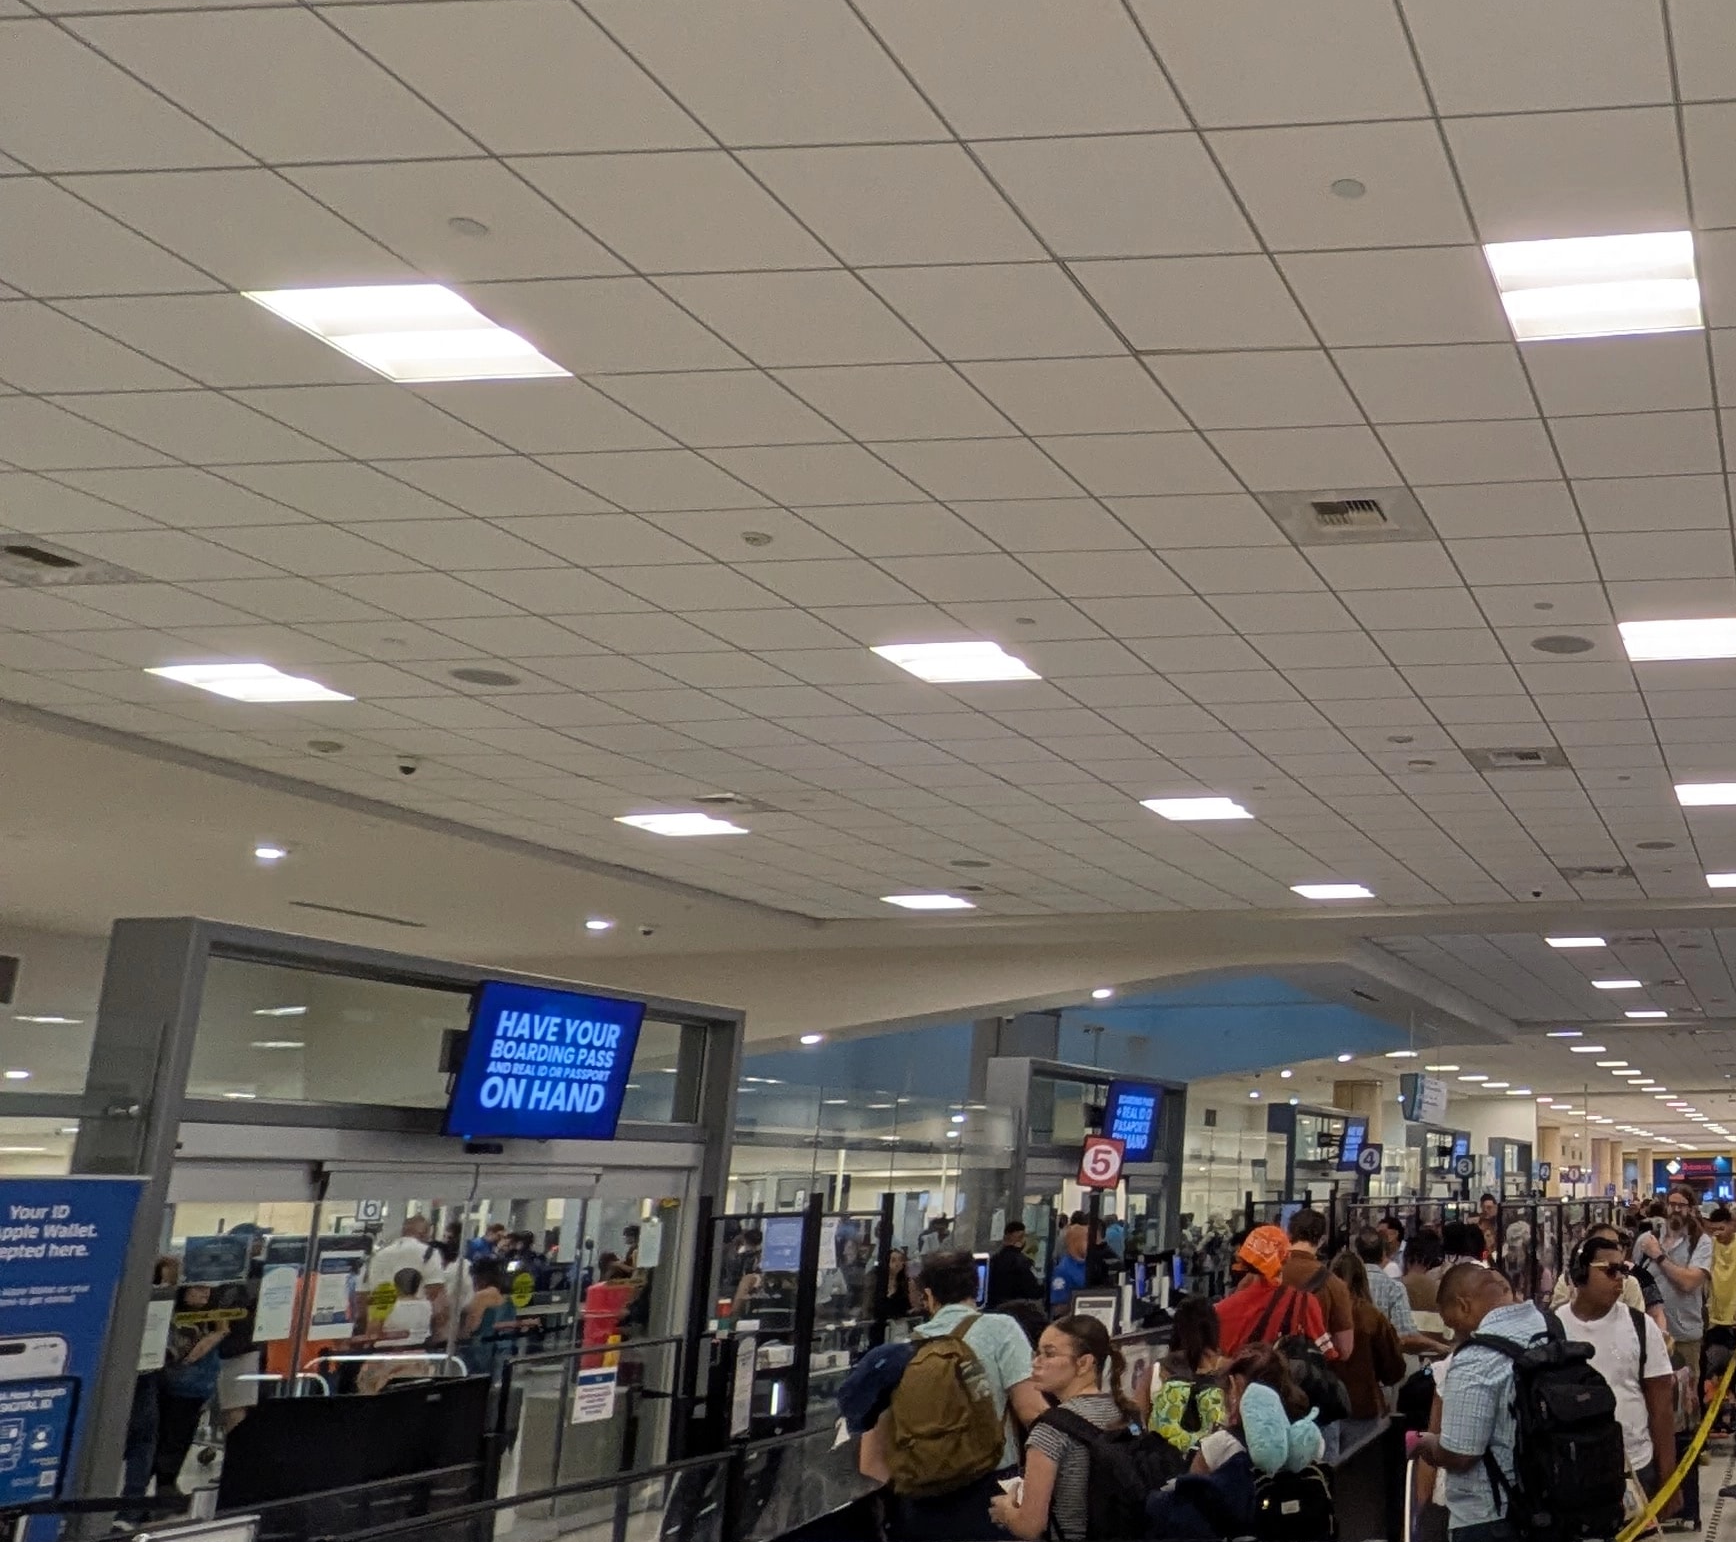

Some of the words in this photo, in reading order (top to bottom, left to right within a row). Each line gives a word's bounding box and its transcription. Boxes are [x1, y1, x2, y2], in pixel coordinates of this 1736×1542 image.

[496, 1010, 562, 1042] HAVE
[565, 1018, 621, 1048] YOUR
[490, 1039, 576, 1064] BOARDING
[577, 1048, 615, 1068] PASS
[486, 1061, 512, 1074] AND
[512, 1063, 535, 1076] REAL
[537, 1064, 549, 1076] ID
[549, 1066, 562, 1078] OR
[564, 1067, 611, 1082] PASSPORT
[479, 1076, 527, 1109] ON
[528, 1080, 605, 1113] HAND
[1090, 1148, 1112, 1176] 5
[1364, 1151, 1375, 1168] 4
[1460, 1160, 1469, 1174] 3
[10, 1205, 48, 1220] Your
[52, 1205, 71, 1219] ID
[0, 1224, 39, 1241] pple
[0, 1244, 46, 1261] epted
